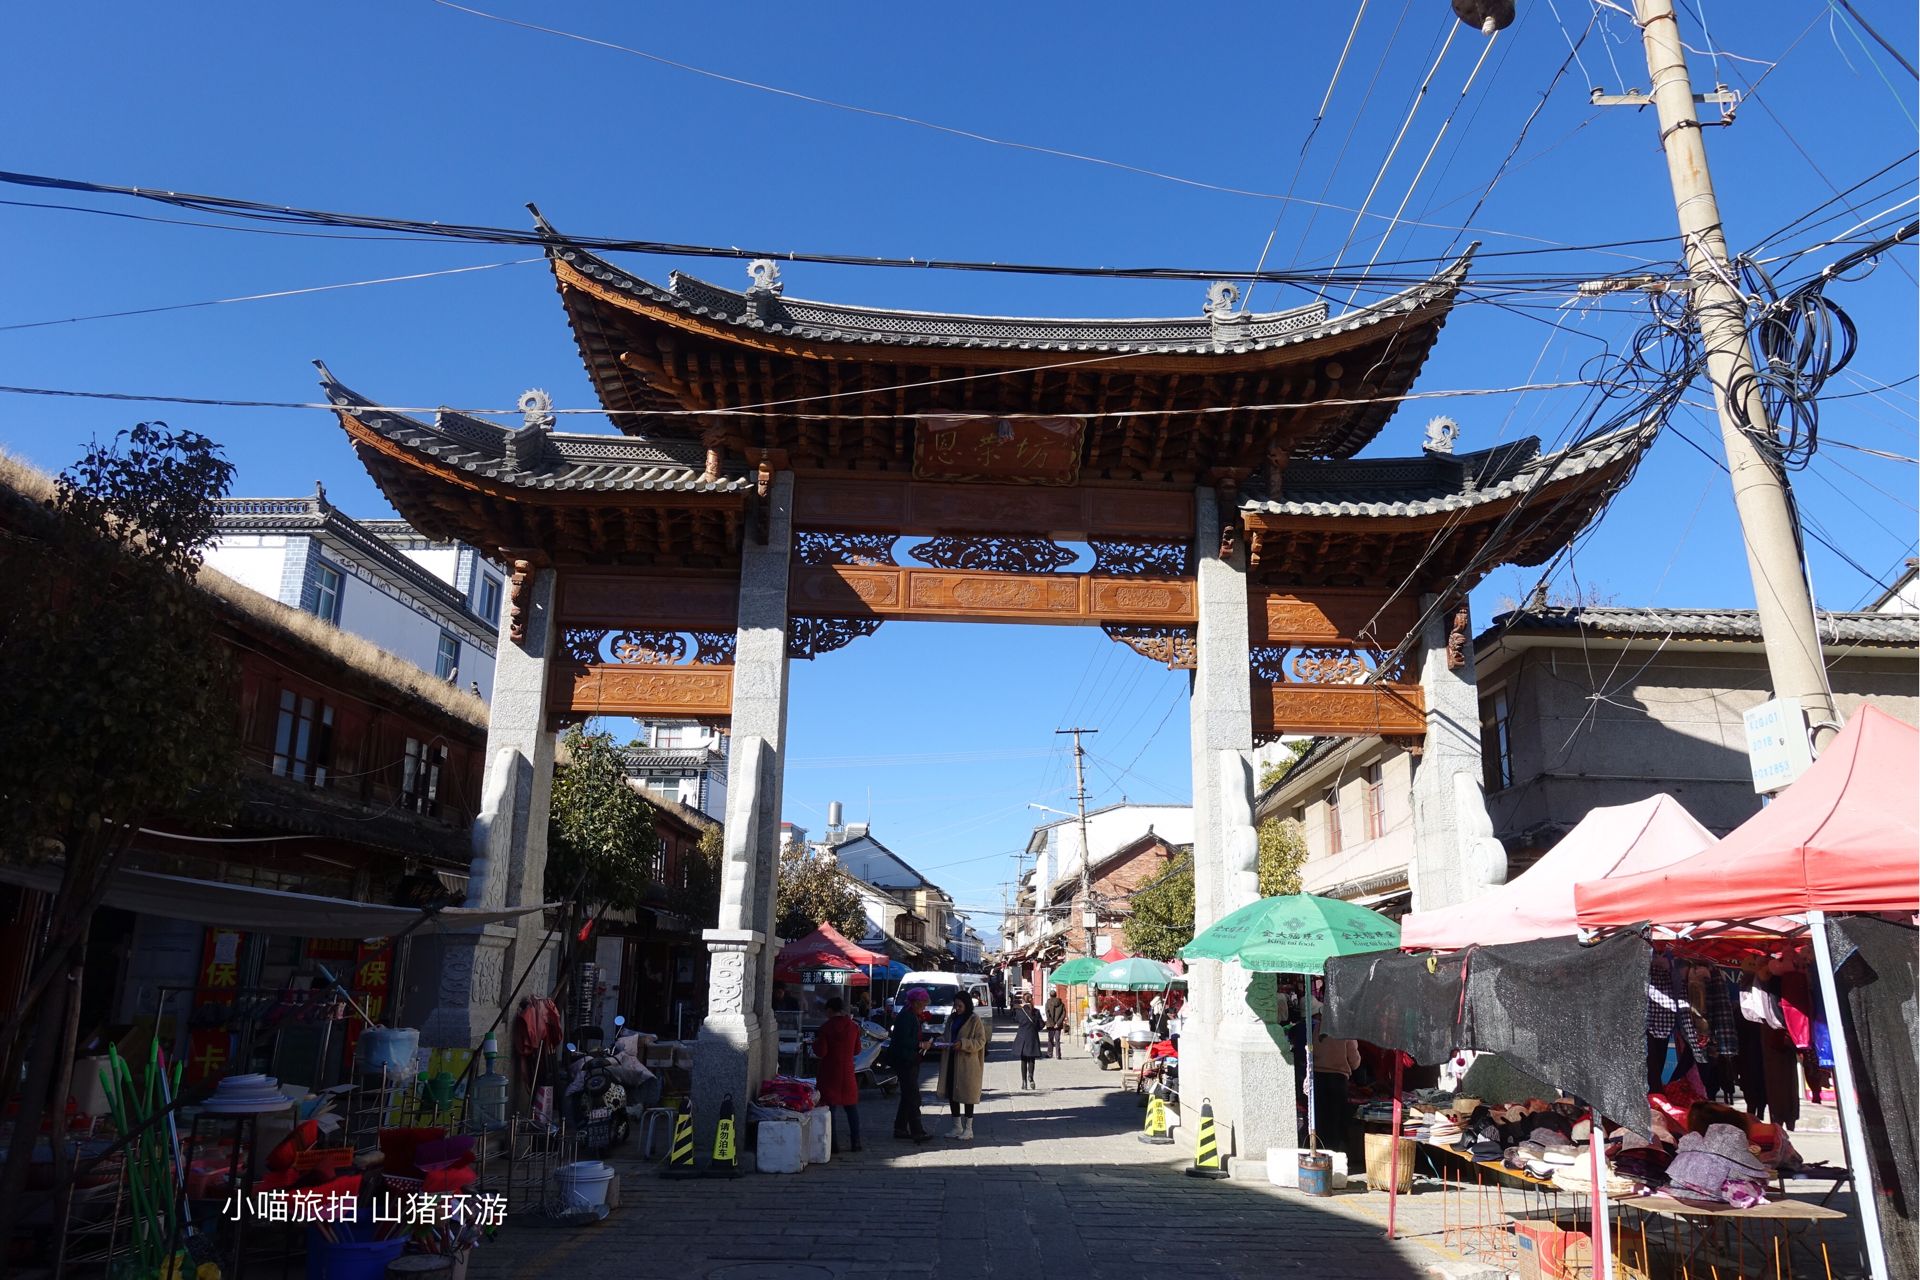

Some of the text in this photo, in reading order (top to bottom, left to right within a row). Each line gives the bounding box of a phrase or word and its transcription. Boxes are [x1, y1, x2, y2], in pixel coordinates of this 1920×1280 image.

[1156, 1101, 1164, 1129] 请勿泊车
[719, 1122, 730, 1157] 请勿泊车
